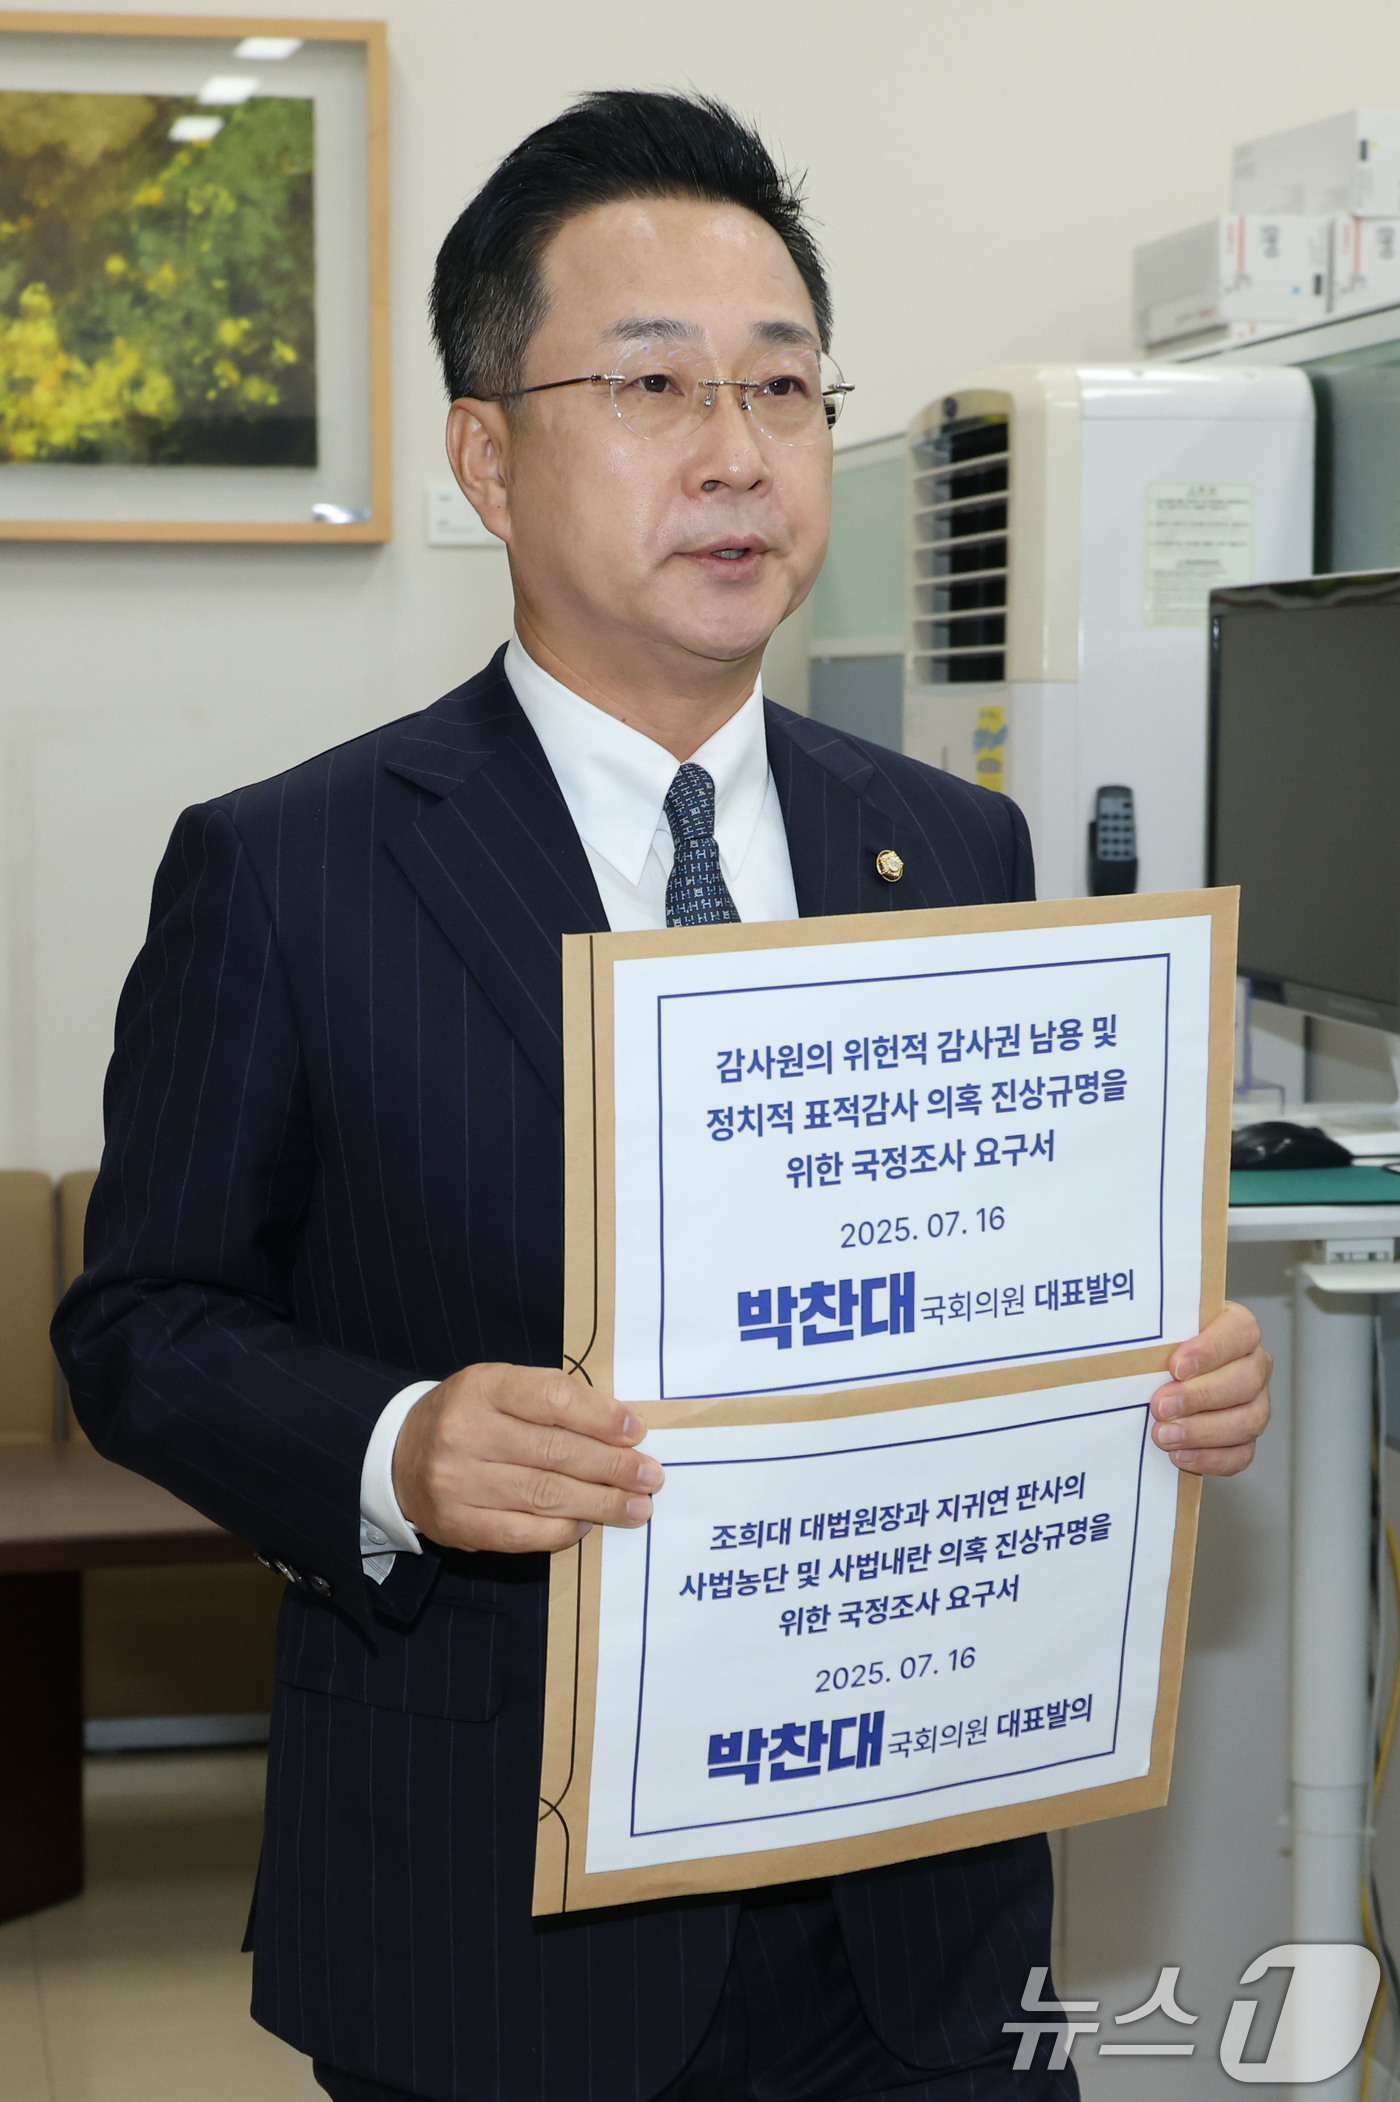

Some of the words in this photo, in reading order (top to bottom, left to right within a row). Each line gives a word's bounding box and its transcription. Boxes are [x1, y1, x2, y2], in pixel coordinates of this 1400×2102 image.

[716, 1040, 833, 1084] 감사원의
[843, 1031, 927, 1072] 위헌적
[936, 1023, 1021, 1064] 감사권
[1030, 1018, 1084, 1055] 남용
[1092, 1013, 1117, 1049] 및
[706, 1100, 793, 1142] 정치적
[803, 1088, 919, 1130] 표적감사
[926, 1082, 983, 1120] 의혹
[991, 1068, 1128, 1114] 진상규명을
[785, 1151, 844, 1189] 위한
[851, 1138, 967, 1182] 국정조사
[973, 1128, 1055, 1168] 요구서
[840, 1216, 918, 1249] 2025.
[927, 1210, 967, 1238] 07.
[976, 1205, 1005, 1233] 16
[737, 1270, 916, 1351] 박찬대
[920, 1284, 1025, 1326] 국회의원
[1034, 1268, 1134, 1312] 대표발의
[709, 1516, 792, 1551] 조희대
[799, 1498, 930, 1542] 대법원장과
[935, 1485, 1010, 1523] 지귀연
[1015, 1471, 1086, 1512] 판사의
[678, 1563, 790, 1602] 사법농단
[797, 1558, 821, 1590] 및
[827, 1542, 933, 1584] 사법내란
[937, 1535, 988, 1567] 의혹
[993, 1511, 1113, 1561] 진상규명을
[778, 1603, 832, 1637] 위한
[837, 1587, 941, 1629] 국정조사
[945, 1573, 1020, 1611] 요구서
[814, 1660, 891, 1694] 2025.
[900, 1653, 939, 1680] 07.
[948, 1646, 976, 1672] 16
[706, 1709, 886, 1786] 박찬대
[887, 1715, 989, 1759] 국회의원
[996, 1693, 1094, 1738] 대표발의
